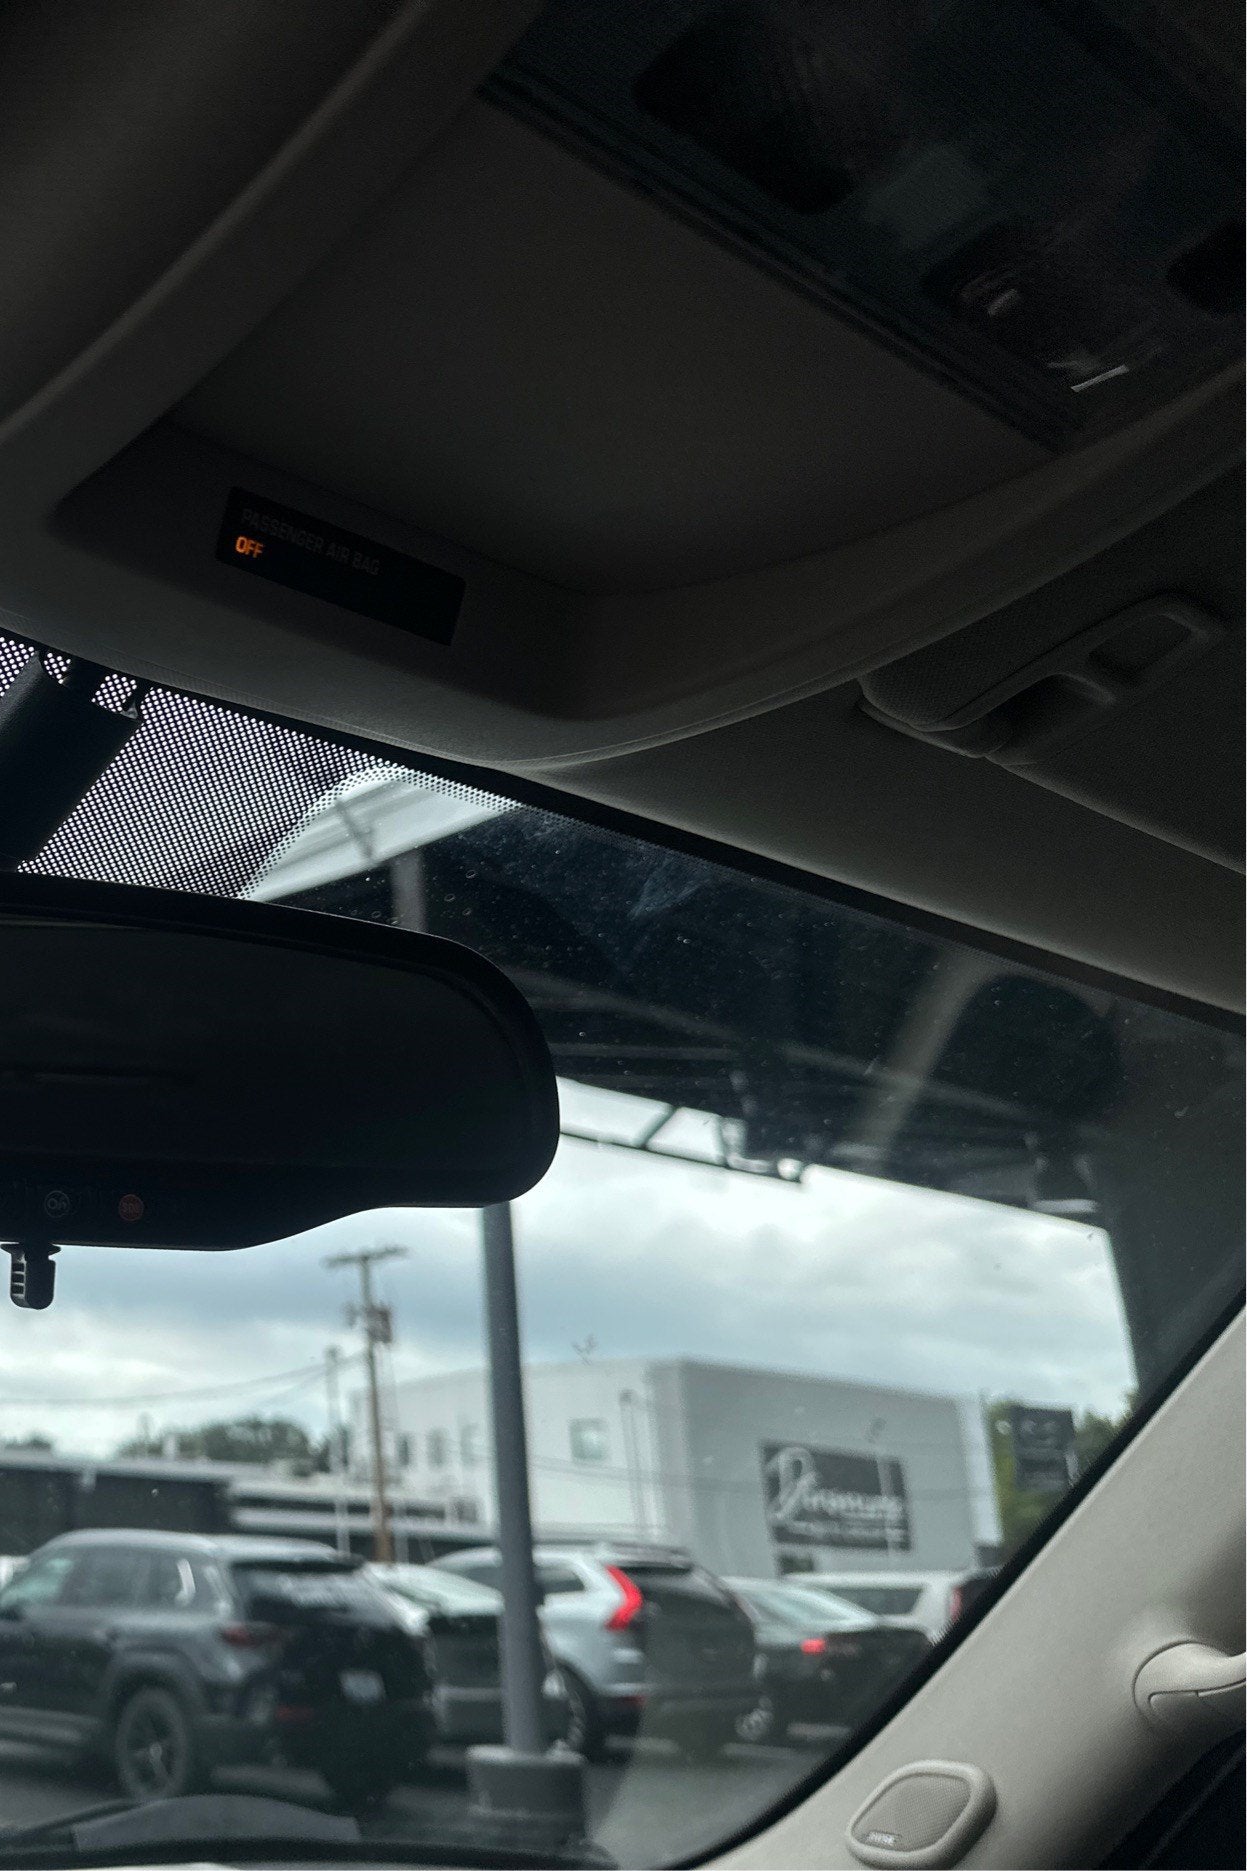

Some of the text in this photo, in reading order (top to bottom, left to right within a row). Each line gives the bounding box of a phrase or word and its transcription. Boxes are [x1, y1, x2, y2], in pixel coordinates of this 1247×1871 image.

[234, 535, 264, 558] OFF
[241, 508, 380, 575] PASSENGER AIR BAG
